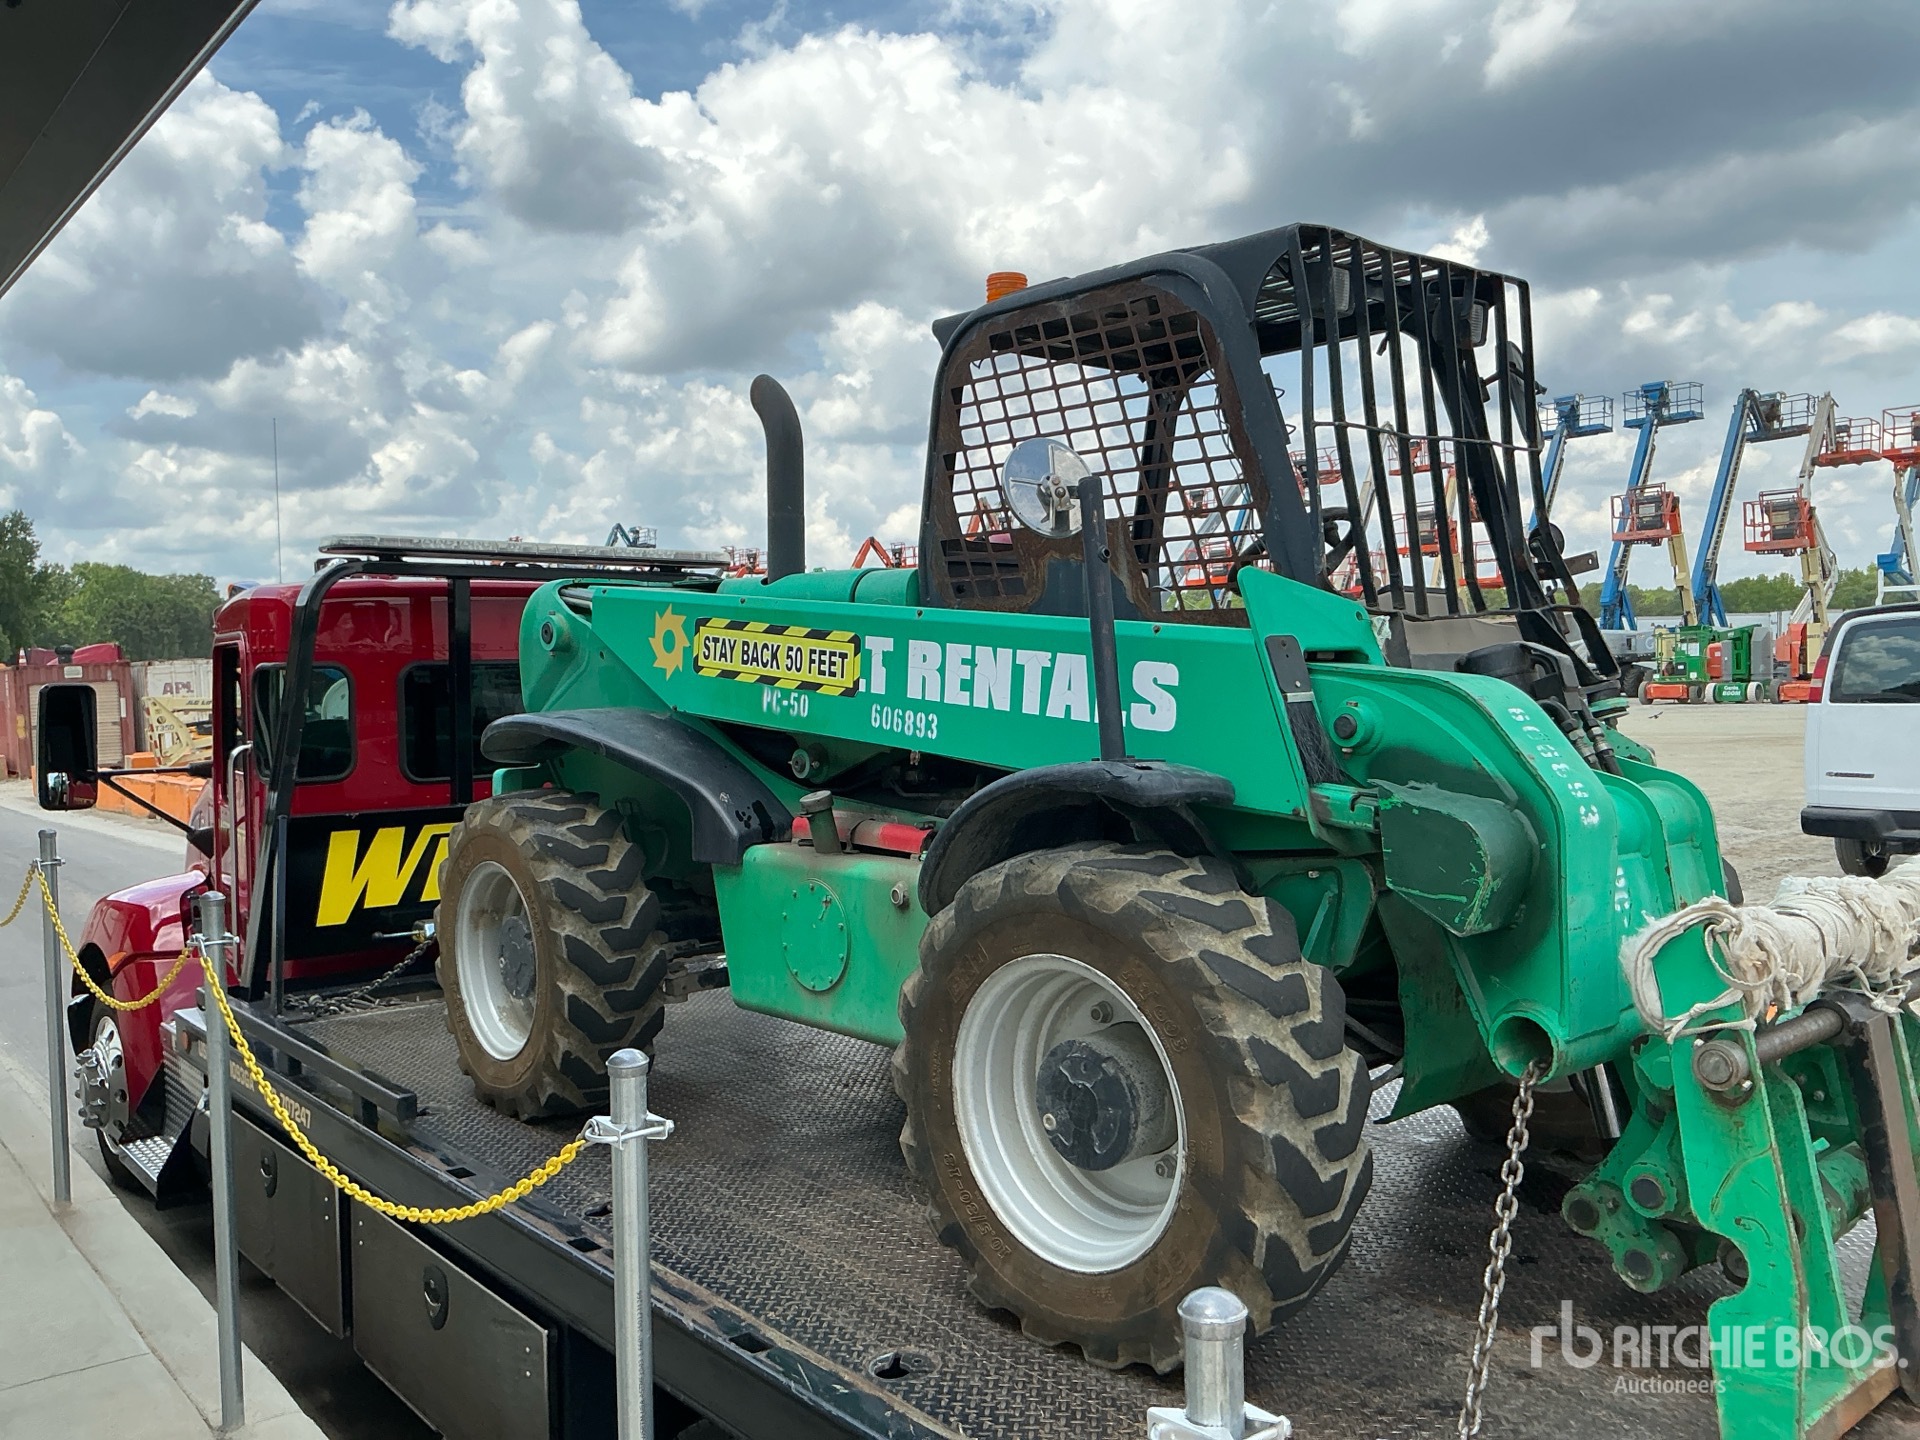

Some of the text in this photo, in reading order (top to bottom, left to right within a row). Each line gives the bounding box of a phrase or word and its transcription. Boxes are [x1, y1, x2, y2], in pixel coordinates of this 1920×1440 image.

[702, 635, 848, 679] STAY BACK 50 FEET
[762, 687, 809, 718] PC-50
[870, 703, 938, 740] 606893
